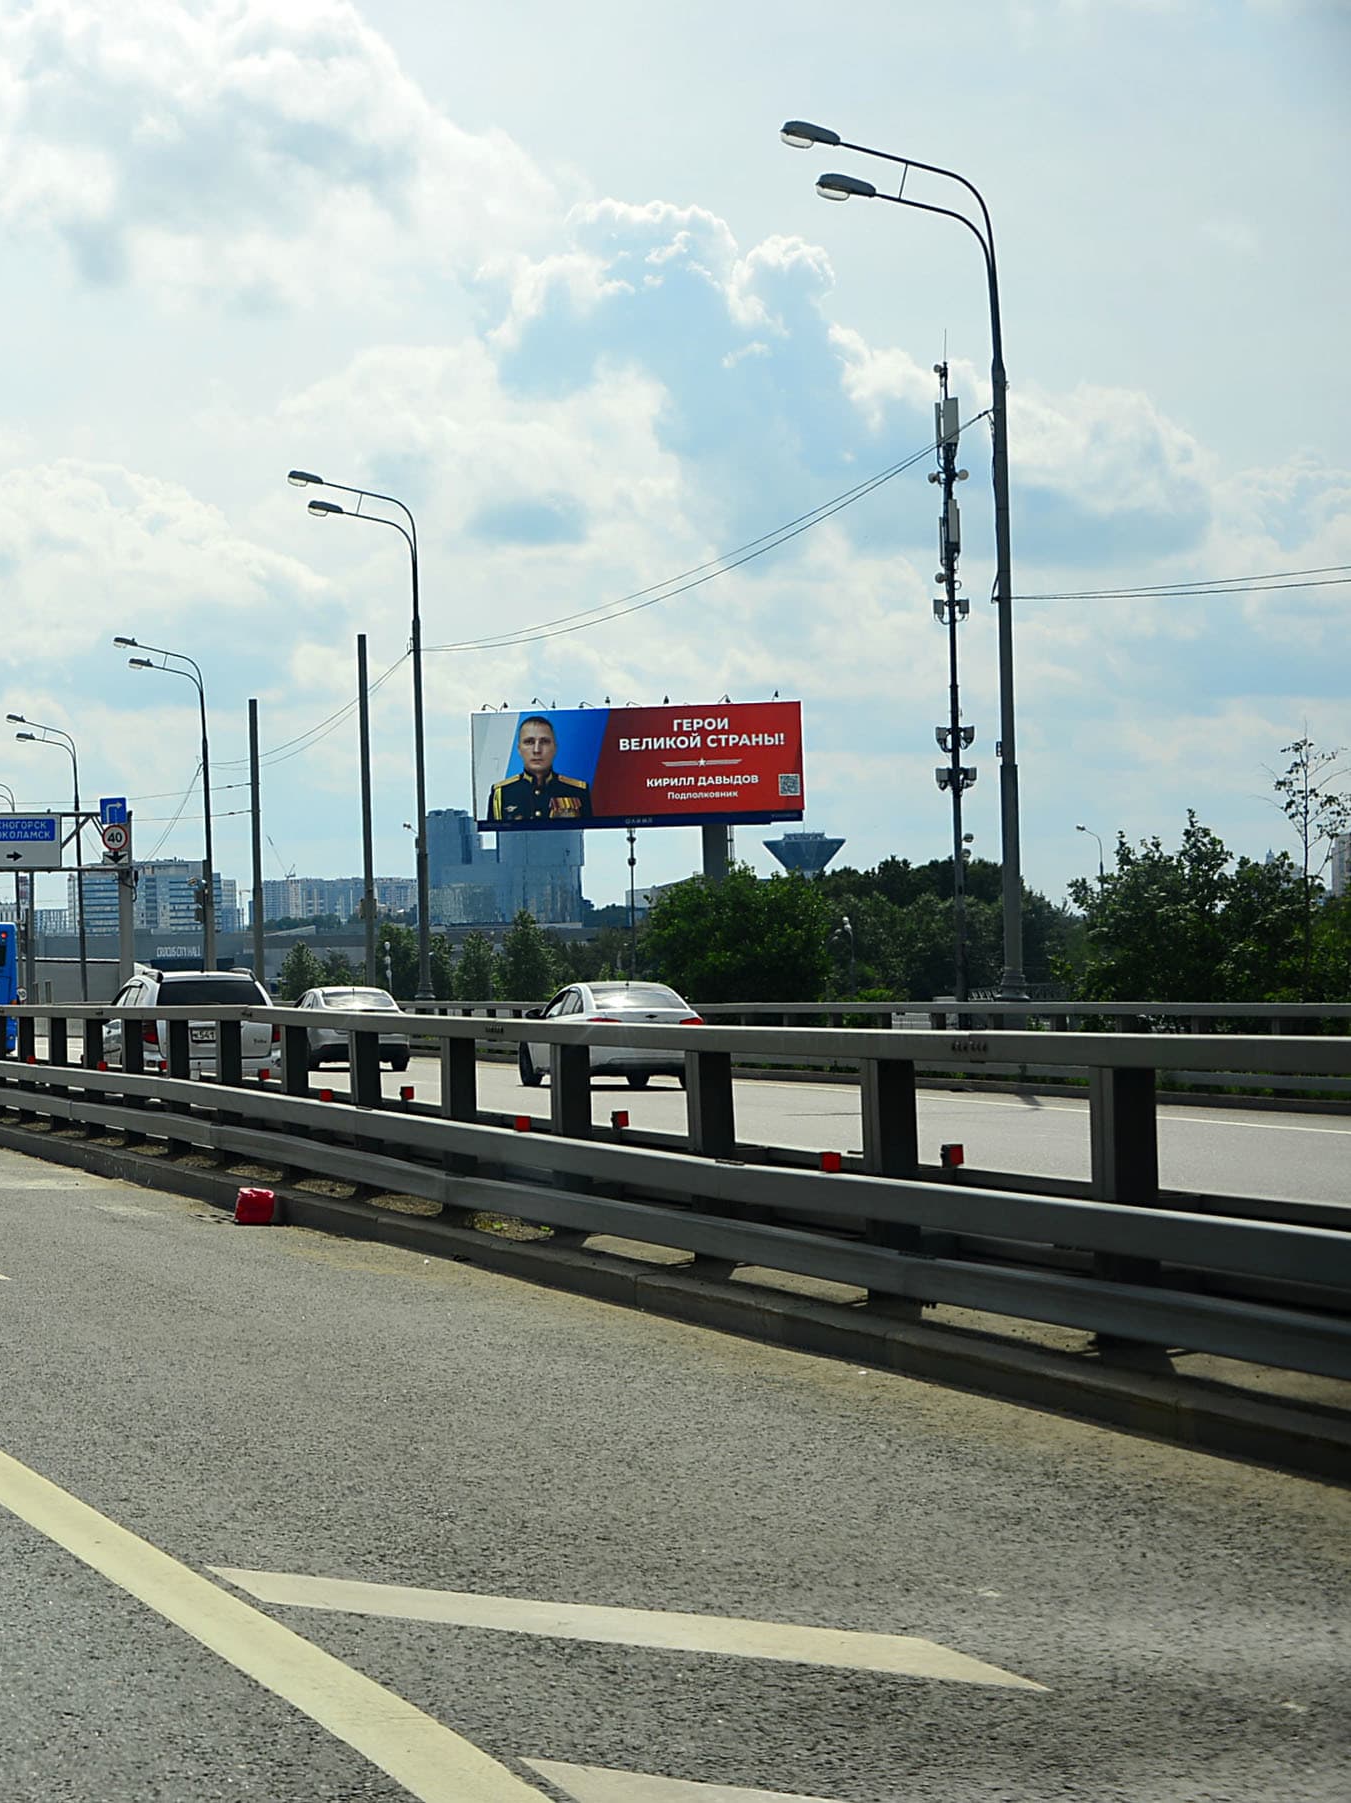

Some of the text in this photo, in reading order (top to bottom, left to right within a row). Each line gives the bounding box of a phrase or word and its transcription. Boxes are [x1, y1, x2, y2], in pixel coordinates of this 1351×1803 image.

[672, 717, 729, 732] ГЕРОИ
[619, 733, 785, 751] ВЕЛИКОЙ СТРАНЫ!
[646, 774, 759, 788] КИРИЛЛ ДАВЫДОВ
[667, 790, 739, 800] Подполковник
[107, 832, 123, 843] 40
